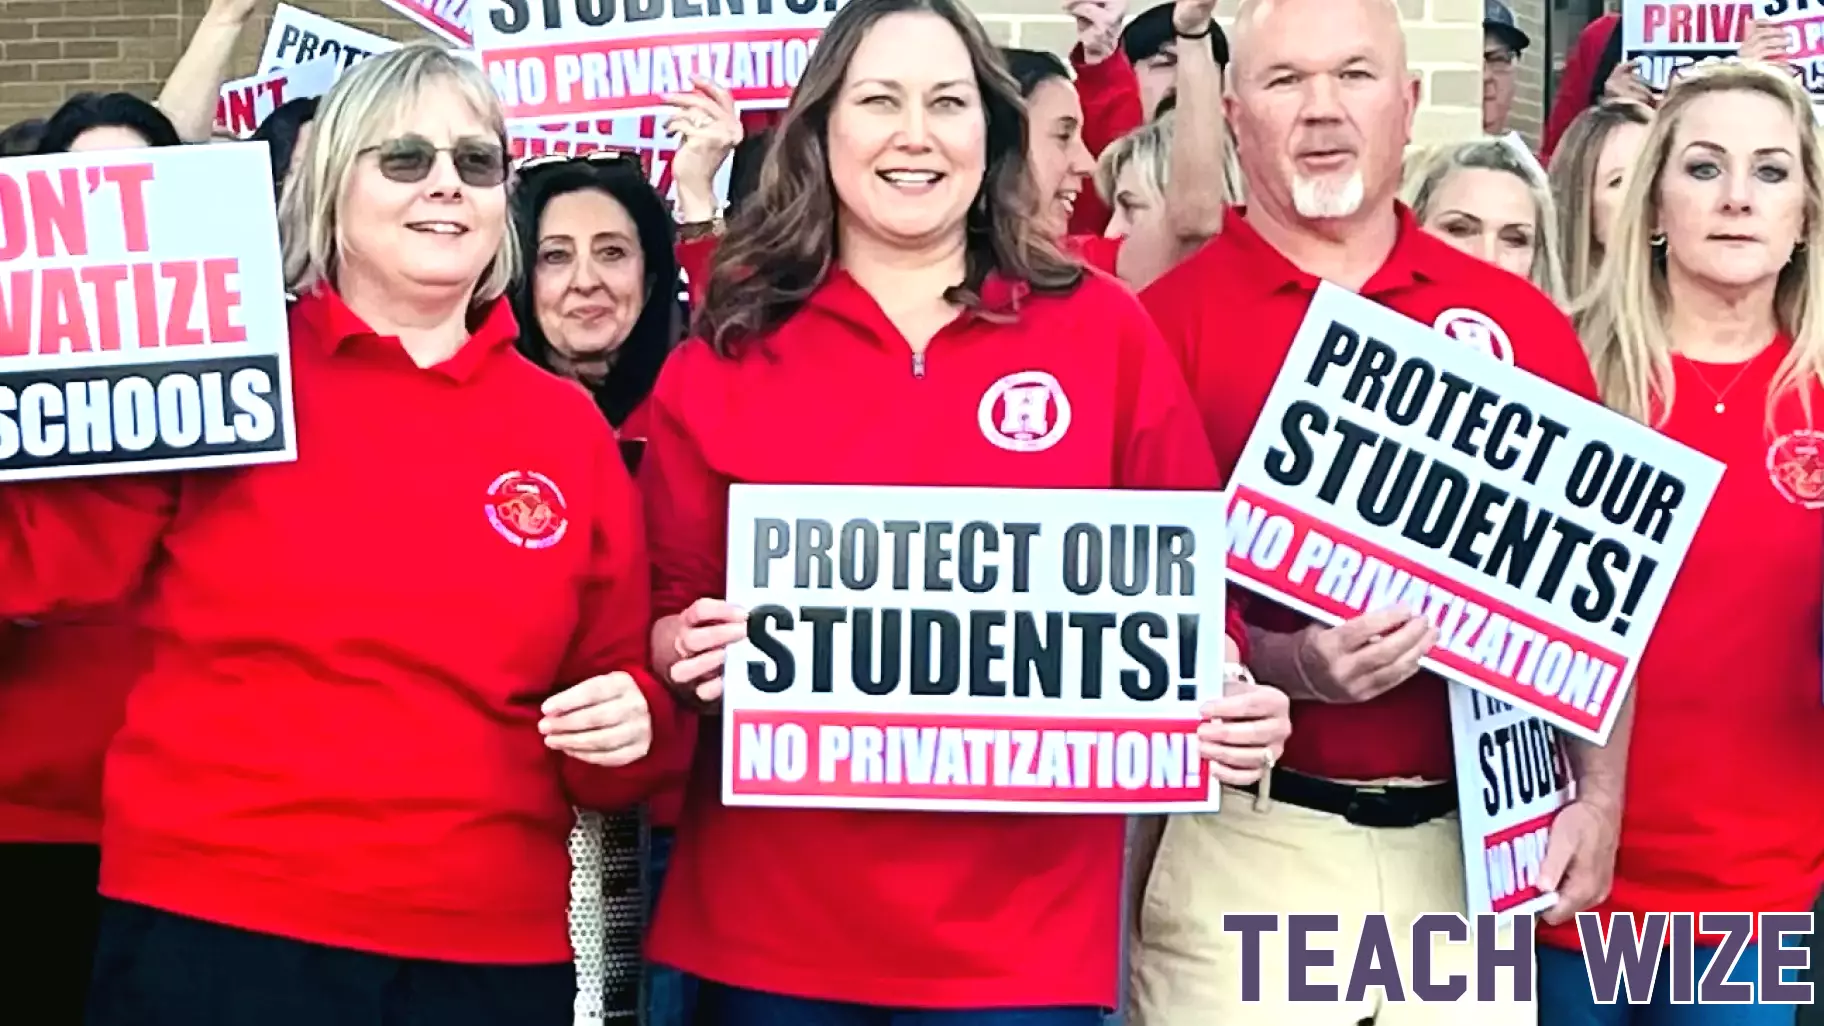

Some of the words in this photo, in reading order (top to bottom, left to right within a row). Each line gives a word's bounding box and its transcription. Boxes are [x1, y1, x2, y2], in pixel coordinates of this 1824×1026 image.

[276, 24, 372, 71] PROT
[488, 57, 547, 107] NO
[554, 38, 820, 104] PRIVATIZATIO
[1304, 319, 1571, 486] PROTECT
[1565, 441, 1687, 545] OUR
[752, 517, 1042, 594] PROTECT
[1062, 522, 1197, 597] OUR
[1263, 400, 1658, 637] STUDENTS!
[746, 603, 1201, 702] STUDENTS!
[1226, 498, 1295, 572] NO
[1287, 529, 1618, 718] PRIVATIZATION!
[738, 723, 808, 783] NO
[818, 725, 1201, 790] PRIVATIZATION!
